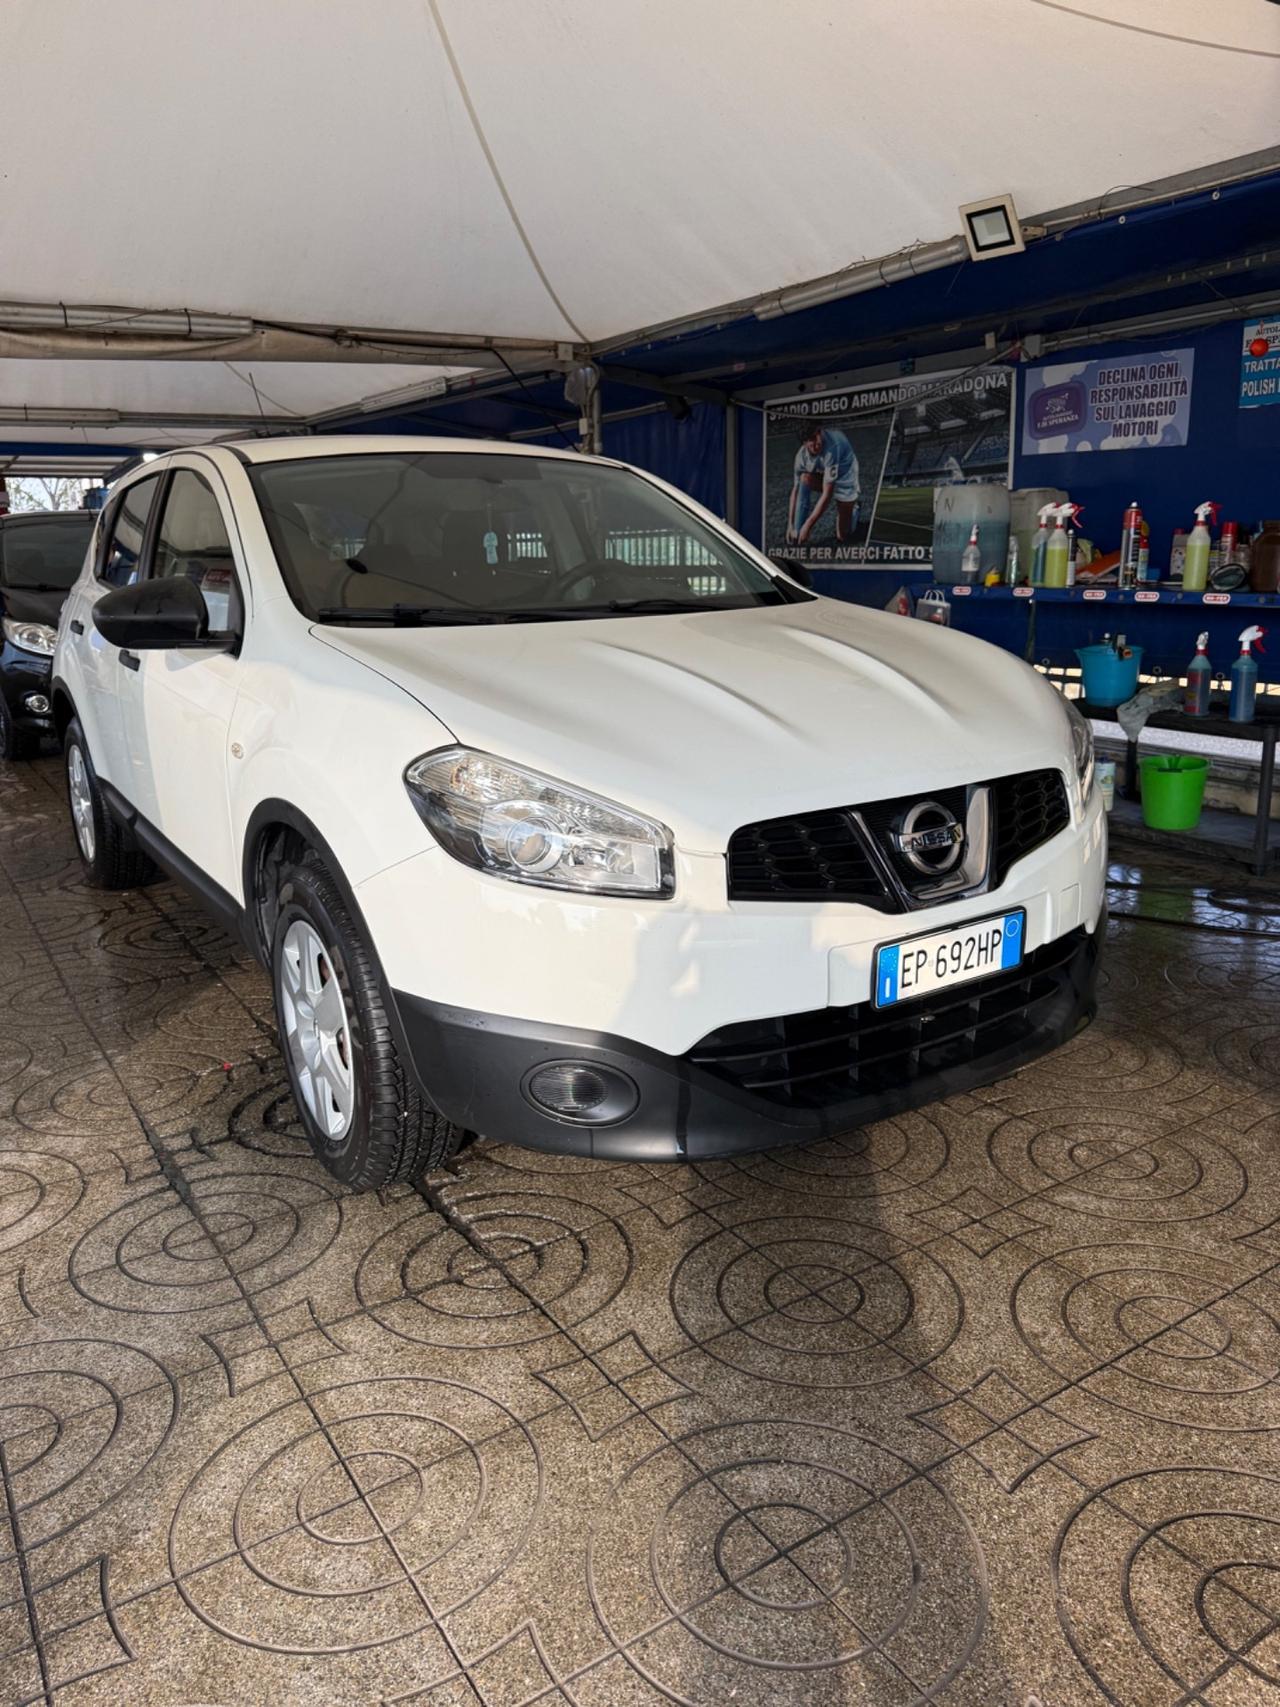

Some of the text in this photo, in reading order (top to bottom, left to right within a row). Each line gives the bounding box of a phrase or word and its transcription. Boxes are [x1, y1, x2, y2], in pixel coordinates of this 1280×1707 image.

[1098, 362, 1179, 386] DECLINA OGNI
[1241, 378, 1276, 397] POLISH
[769, 402, 809, 421] STADIO
[812, 398, 848, 414] DIEGO
[851, 386, 917, 409] ARMANDO
[1095, 400, 1177, 421] SUL LAVAGGIO
[1112, 420, 1159, 438] MOTORI
[768, 547, 807, 560] GRAZIE
[809, 547, 832, 560] PER
[835, 547, 879, 560] AVERCI
[883, 546, 925, 560] FATTO
[911, 825, 962, 850] NISSAN
[901, 929, 1003, 988] EP 692HP
